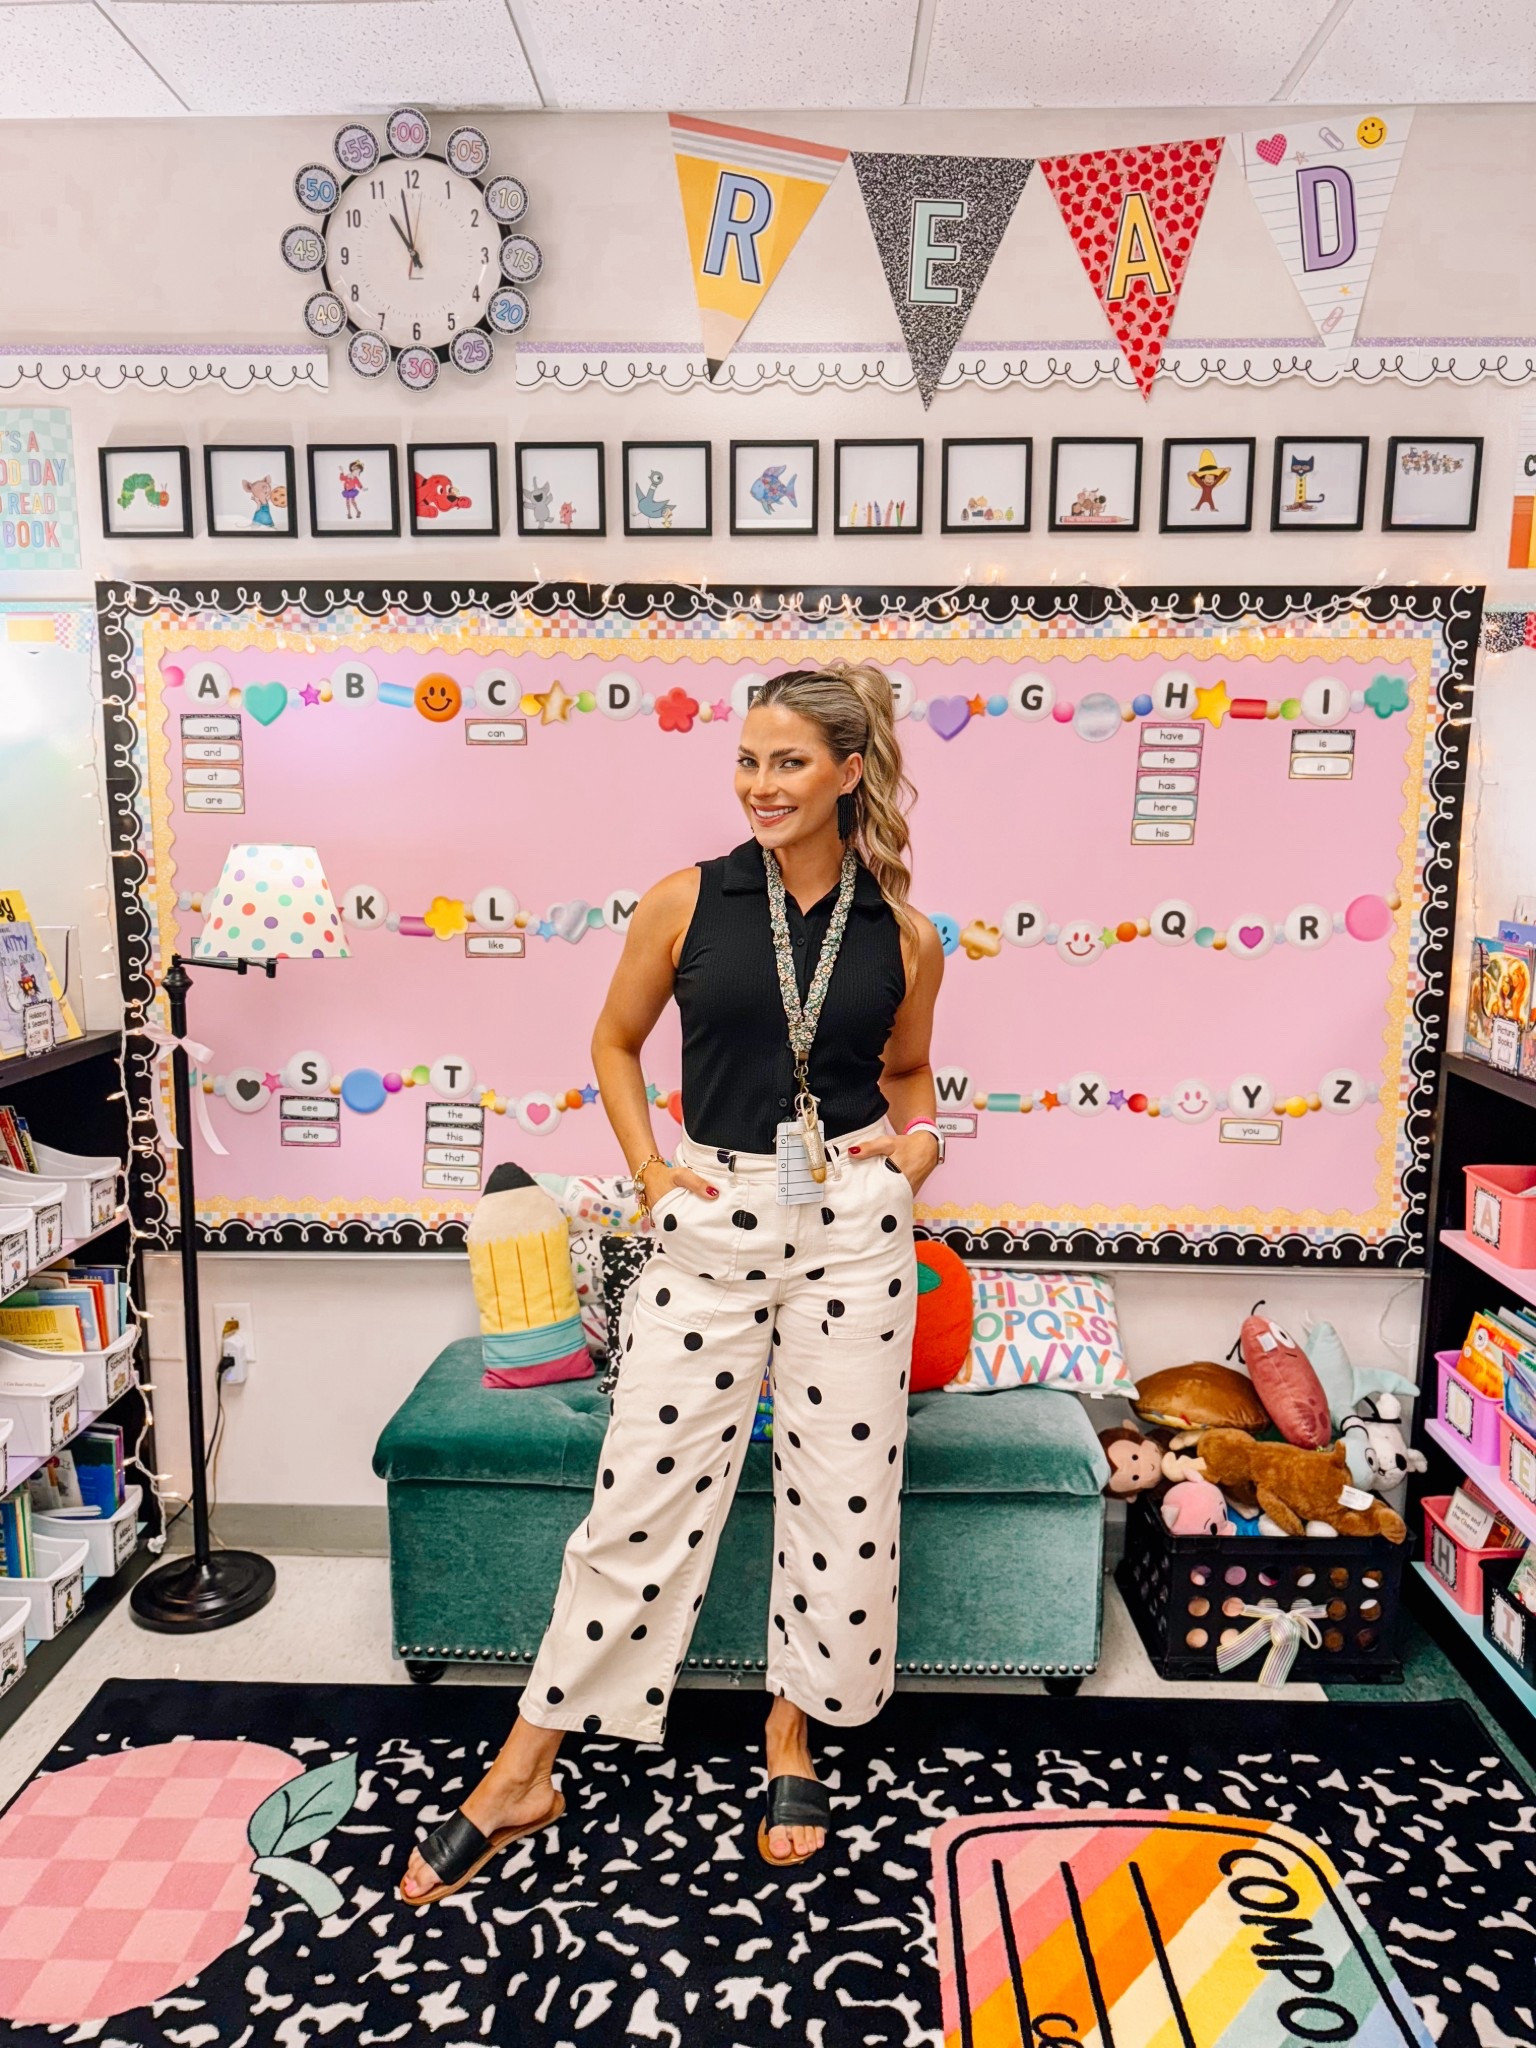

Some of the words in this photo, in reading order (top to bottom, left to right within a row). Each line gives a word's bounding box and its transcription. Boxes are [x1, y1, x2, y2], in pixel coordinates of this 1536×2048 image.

[405, 169, 420, 189] 12
[370, 180, 384, 200] 11
[445, 180, 451, 200] 1
[346, 209, 361, 228] 10
[470, 209, 479, 227] 2
[341, 246, 349, 265] 9
[480, 246, 489, 265] 3
[351, 284, 359, 302] 8
[472, 284, 480, 302] 4
[378, 312, 386, 330] 7
[447, 312, 456, 331] 5
[412, 322, 421, 341] 6
[27, 430, 40, 452] A
[28, 458, 66, 486] DAY
[8, 492, 56, 514] READ
[3, 521, 60, 548] BOOK
[198, 673, 220, 699] A
[345, 672, 365, 699] B
[487, 679, 507, 706] C
[609, 683, 631, 710] D
[1020, 684, 1044, 711] G
[1164, 682, 1189, 709] H
[1322, 688, 1331, 715] I
[487, 730, 506, 738] can
[1159, 729, 1184, 740] have
[1318, 739, 1328, 748] is
[203, 746, 222, 757] and
[1163, 754, 1176, 764] he
[207, 771, 218, 781] at
[1317, 762, 1326, 771] in
[1158, 779, 1176, 790] has
[205, 796, 223, 805] are
[1153, 801, 1178, 812] here
[1155, 828, 1170, 838] his
[355, 895, 376, 920] K
[489, 897, 505, 922] L
[612, 900, 639, 925] M
[1017, 912, 1036, 937] P
[1161, 910, 1186, 939] Q
[1299, 915, 1319, 941] R
[488, 940, 504, 949] like
[1496, 1024, 1516, 1038] Picture
[1497, 1037, 1513, 1049] Books
[301, 1061, 318, 1086] S
[443, 1065, 463, 1089] T
[936, 1076, 968, 1102] W
[1078, 1082, 1099, 1107] X
[1242, 1085, 1262, 1109] Y
[1333, 1079, 1353, 1105] Z
[447, 1109, 463, 1119] the
[302, 1129, 319, 1139] she
[446, 1131, 464, 1142] this
[938, 1123, 957, 1131] was
[1241, 1128, 1260, 1136] you
[444, 1152, 465, 1162] that
[442, 1172, 465, 1184] they
[40, 1212, 58, 1230] Froggy
[1480, 1200, 1493, 1235] A
[56, 1394, 75, 1417] Biscuit
[1519, 1452, 1531, 1490] E
[1438, 1536, 1450, 1574] H
[1502, 1606, 1515, 1648] I
